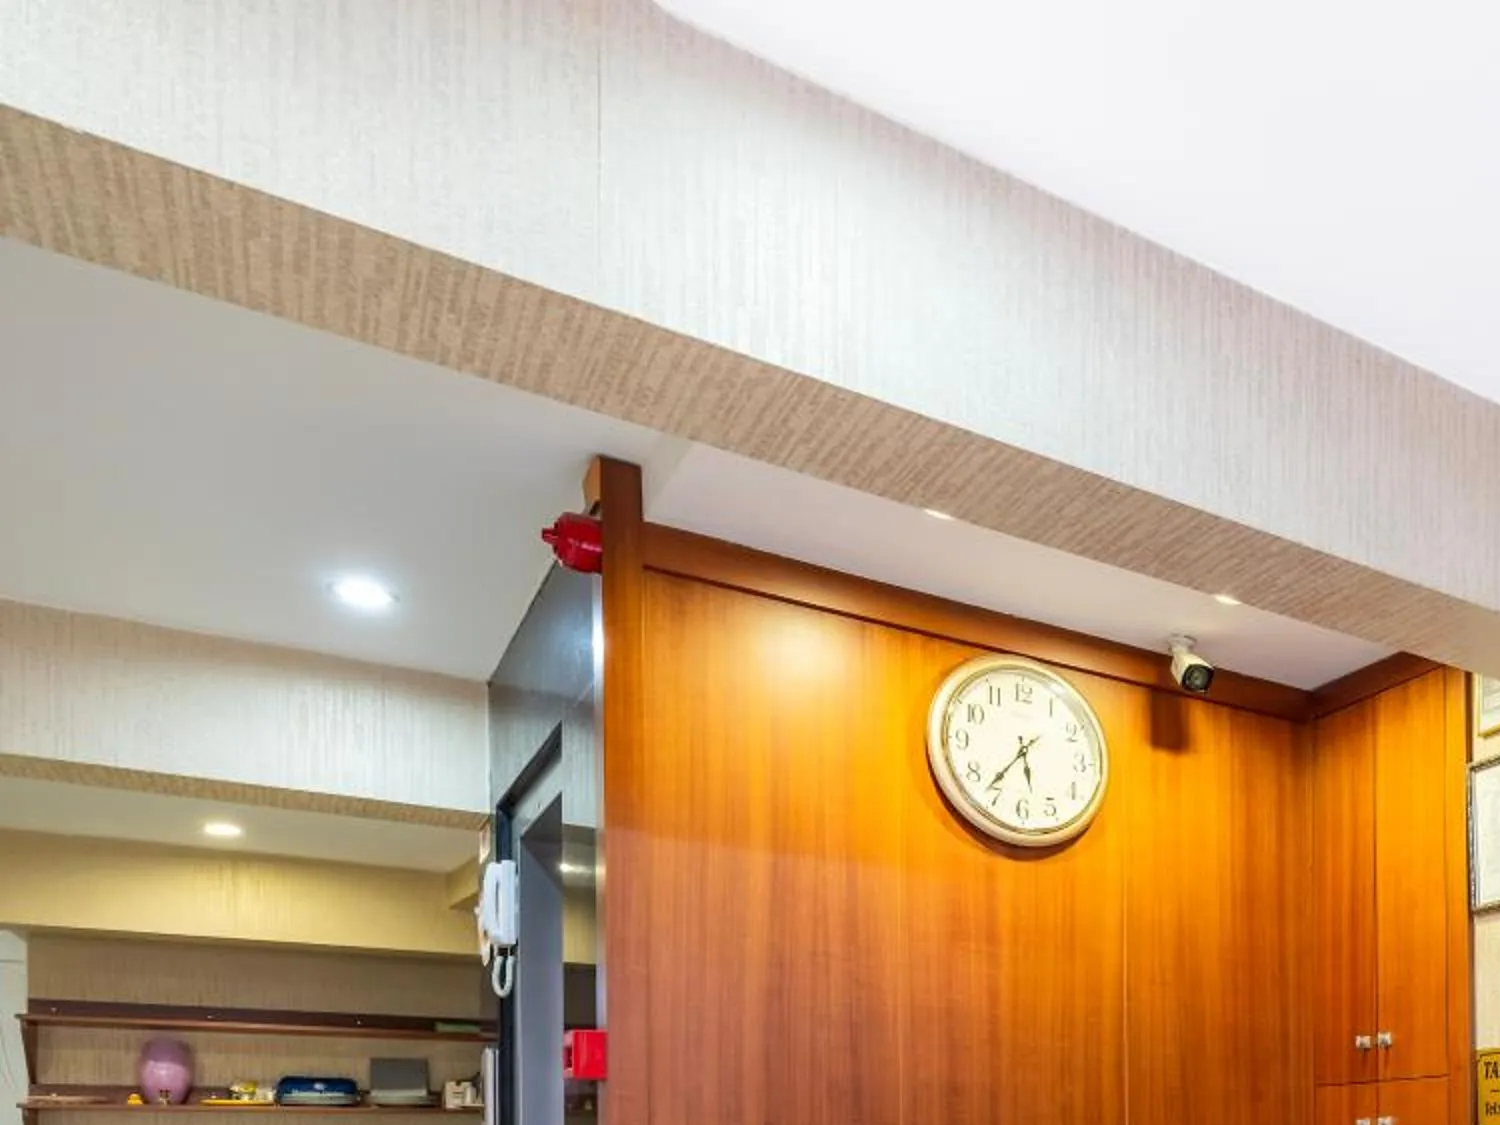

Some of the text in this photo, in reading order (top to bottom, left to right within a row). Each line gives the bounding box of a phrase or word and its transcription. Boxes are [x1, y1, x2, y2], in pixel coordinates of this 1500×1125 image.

[988, 685, 1002, 707] 11
[1014, 680, 1033, 705] 12
[966, 703, 985, 725] 10
[955, 729, 969, 750] 9
[1065, 722, 1079, 743] 2
[966, 760, 981, 783] 8
[1072, 752, 1087, 773] 3
[1015, 798, 1030, 821] 6
[1043, 796, 1057, 817] 5
